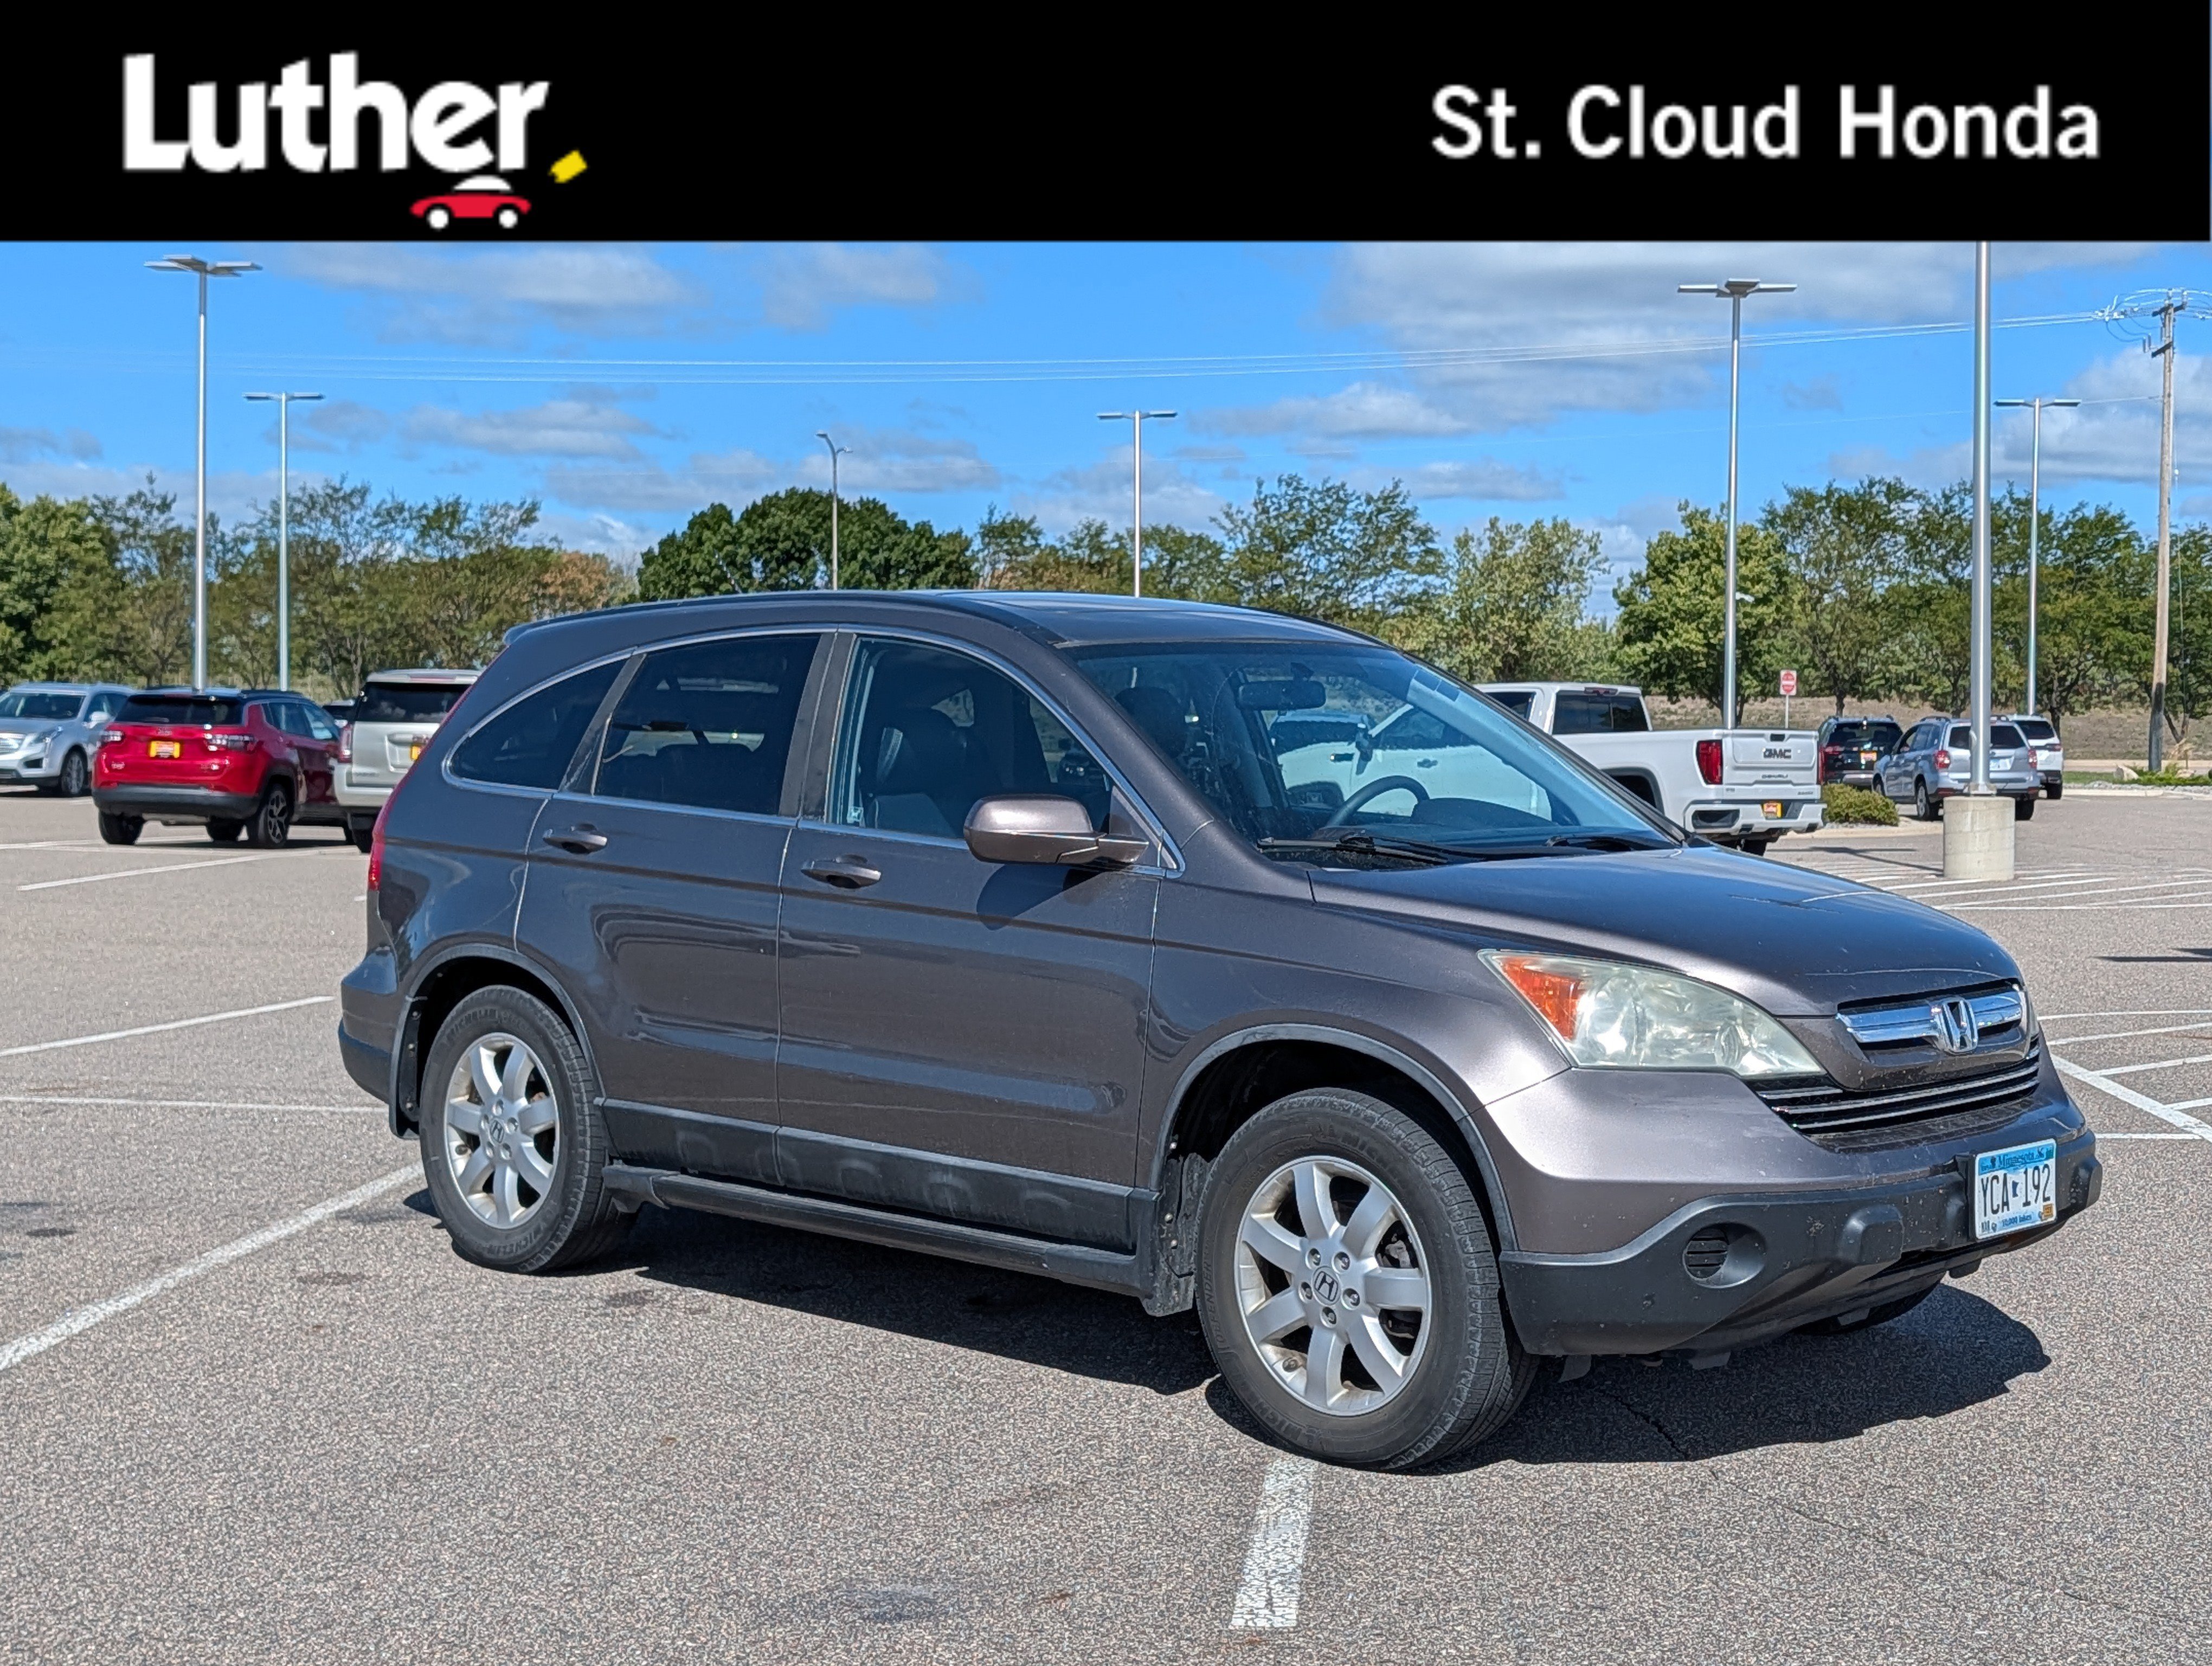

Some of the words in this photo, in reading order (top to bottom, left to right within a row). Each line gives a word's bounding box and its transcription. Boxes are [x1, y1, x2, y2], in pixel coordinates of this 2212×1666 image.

[1763, 748, 1791, 759] GMC
[1981, 1173, 2010, 1217] YCA
[2023, 1164, 2050, 1207] 192
